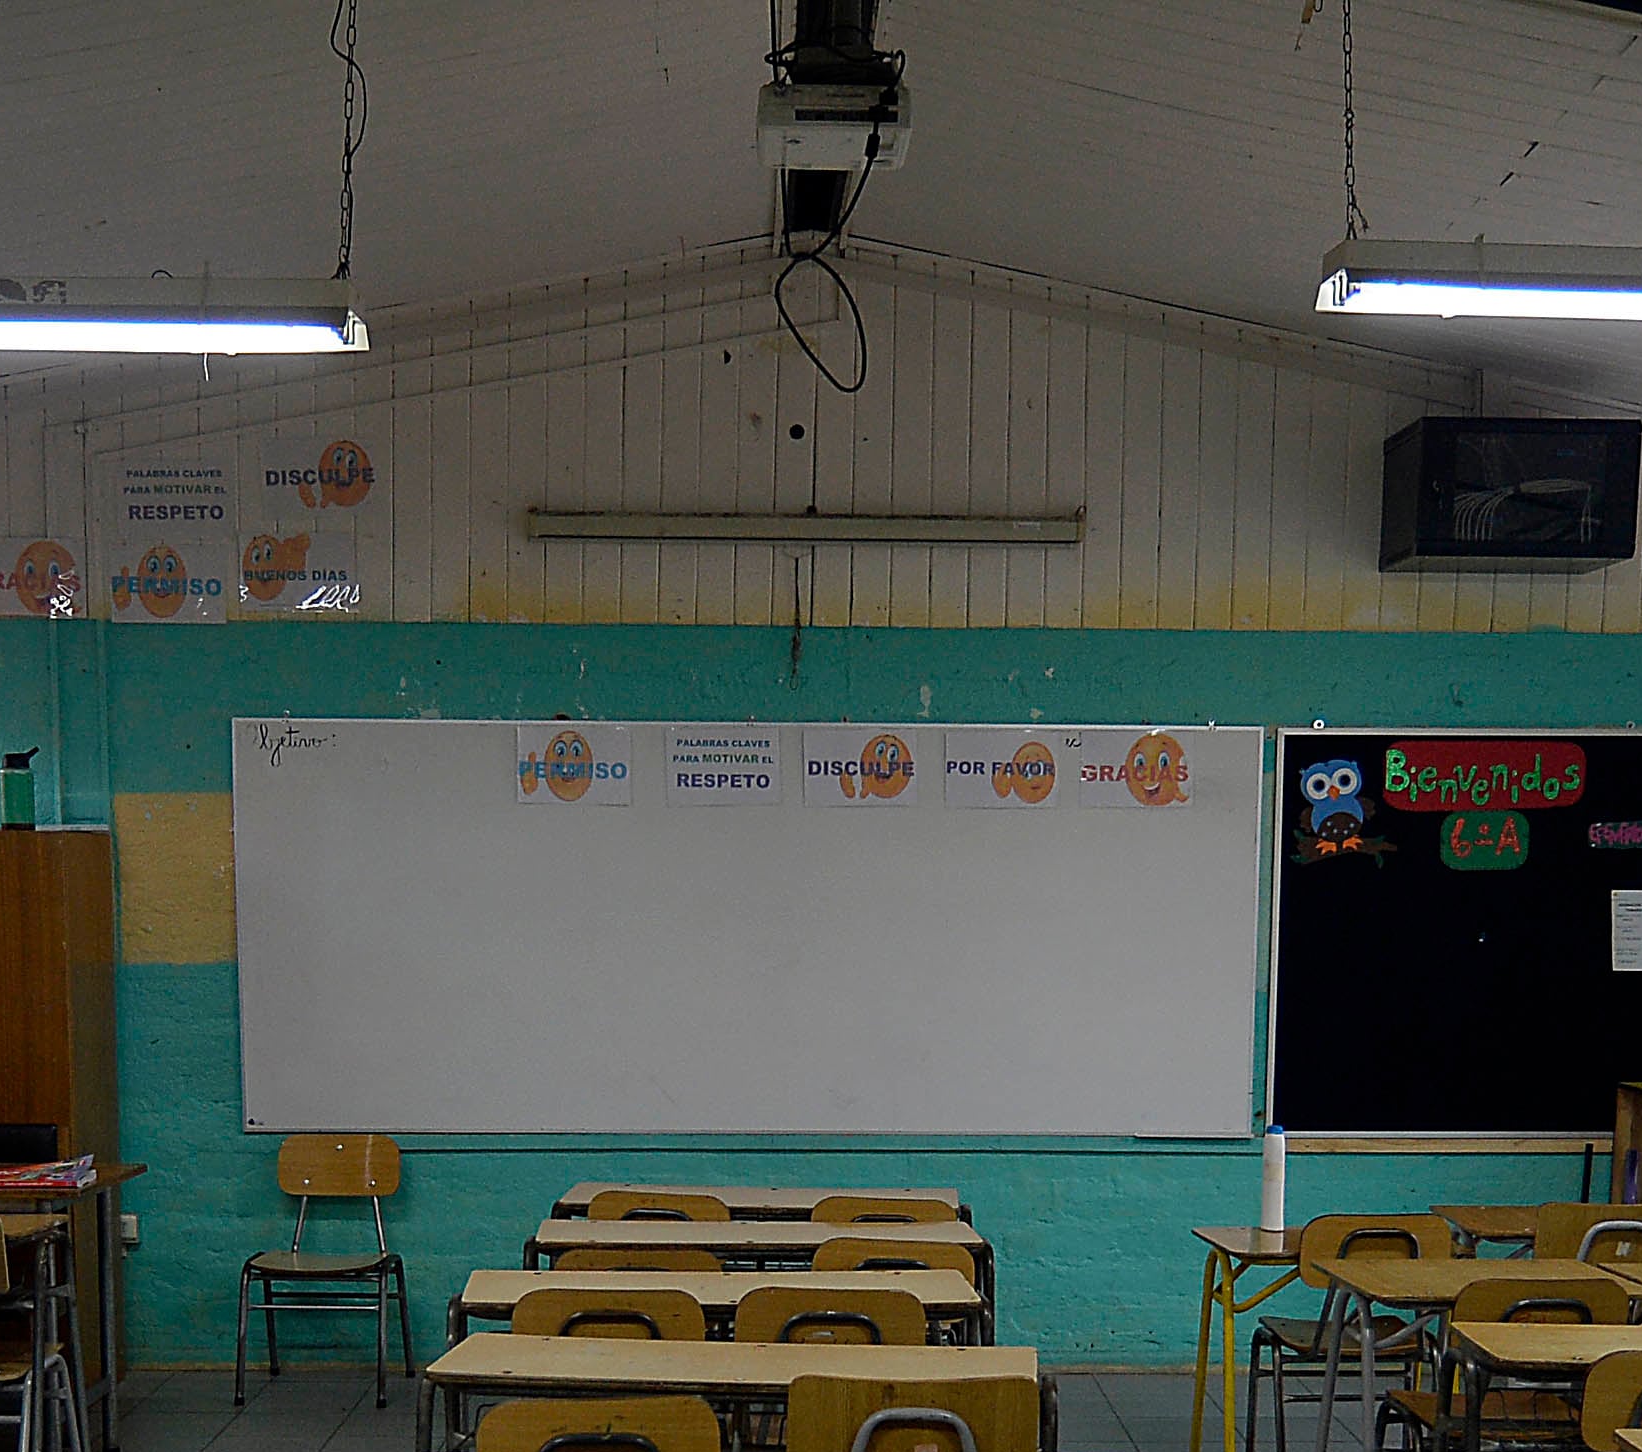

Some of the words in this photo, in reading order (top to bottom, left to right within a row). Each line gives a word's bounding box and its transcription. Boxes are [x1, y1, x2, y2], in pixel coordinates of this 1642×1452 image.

[126, 469, 180, 478] PALABRAS
[182, 469, 222, 478] CLAVES
[265, 467, 375, 486] DISCULPE
[123, 486, 151, 494] PARA
[153, 484, 212, 494] MOTIVAR
[214, 486, 227, 494] EL
[128, 504, 224, 520] RESPETO
[243, 569, 307, 582] BUENOS
[311, 567, 348, 582] DÍAS
[111, 575, 222, 597] PERMISO
[676, 739, 729, 748] PALABRAS
[731, 739, 770, 748] CLAVES
[672, 754, 699, 763] PARA
[702, 753, 759, 763] MOTIVAR
[761, 756, 773, 764] EL
[518, 760, 628, 779] PERMISO
[808, 760, 915, 776] DISCULPE
[946, 760, 985, 775] POR
[991, 760, 1056, 776] FAVOR
[1081, 765, 1189, 782] GRACIAS
[676, 772, 770, 788] RESPETO
[1384, 748, 1581, 805] Bienvenidos
